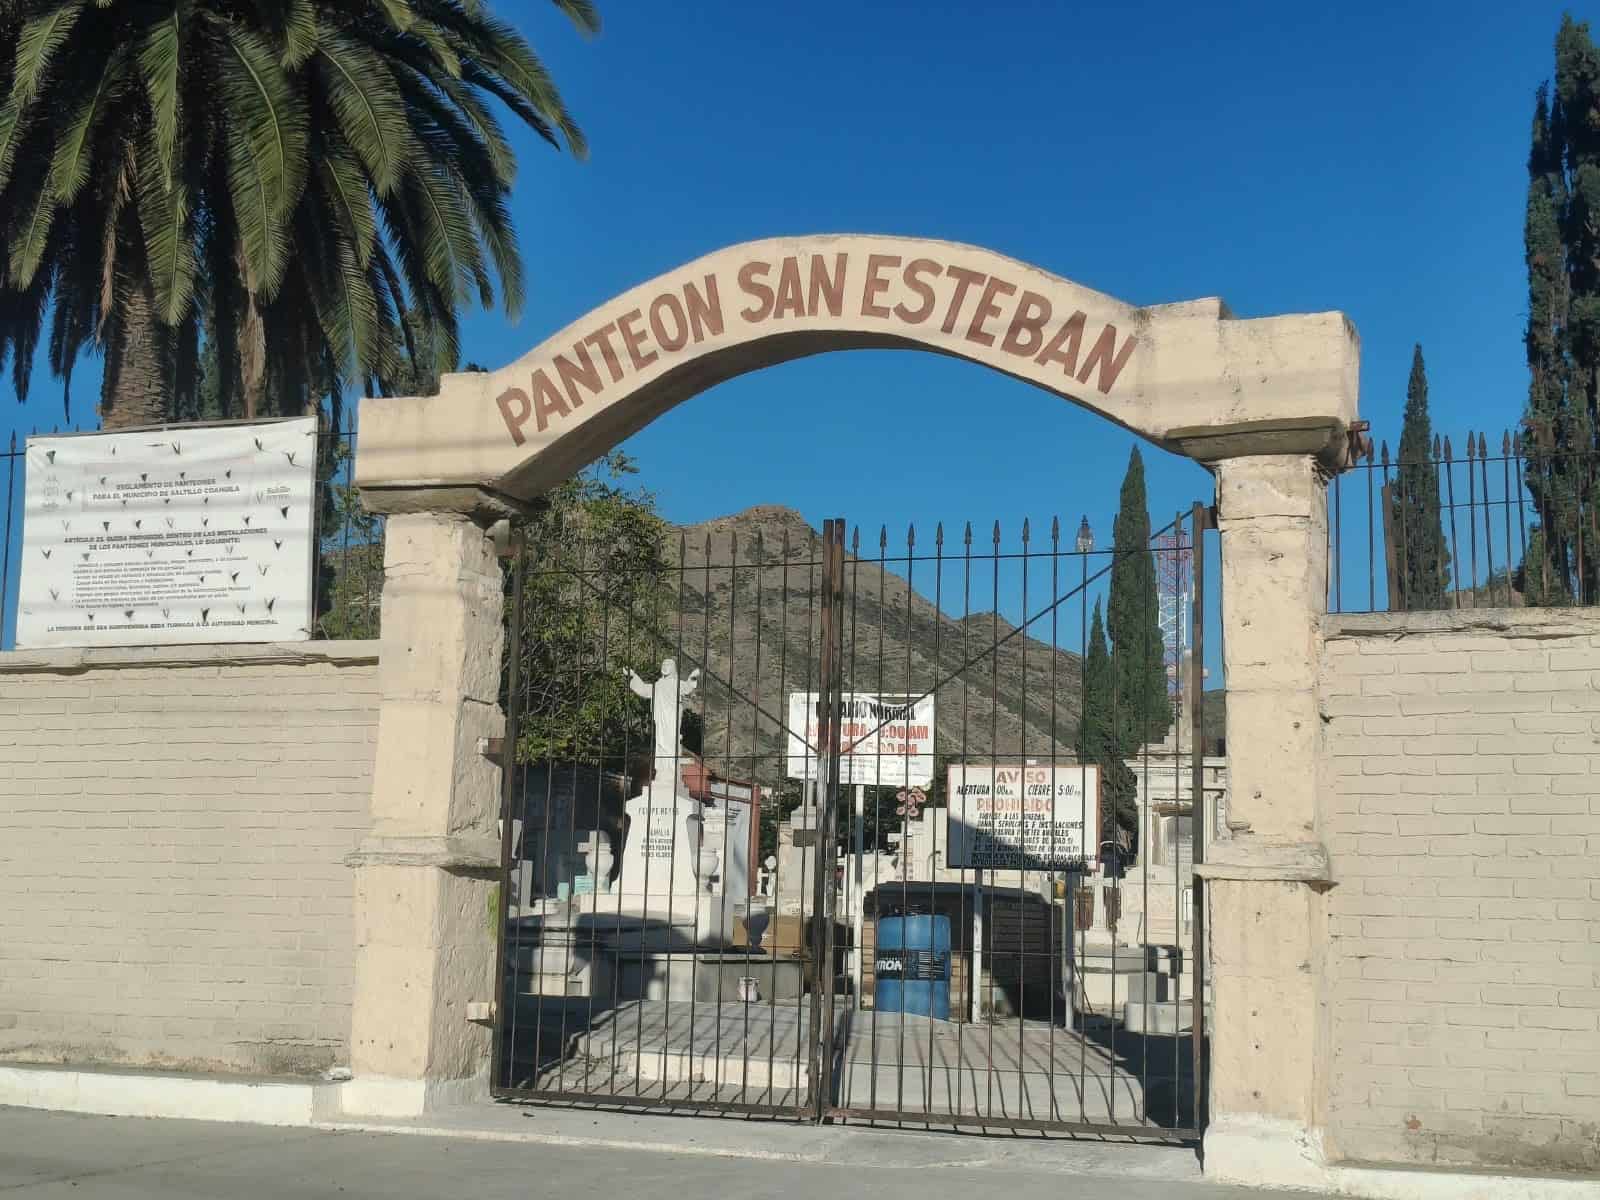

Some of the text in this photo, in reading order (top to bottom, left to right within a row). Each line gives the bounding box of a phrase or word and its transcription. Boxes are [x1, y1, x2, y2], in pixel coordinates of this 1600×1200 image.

[496, 253, 1137, 447] PANTEON SAN ESTEBAN
[996, 771, 1047, 784] AVSO
